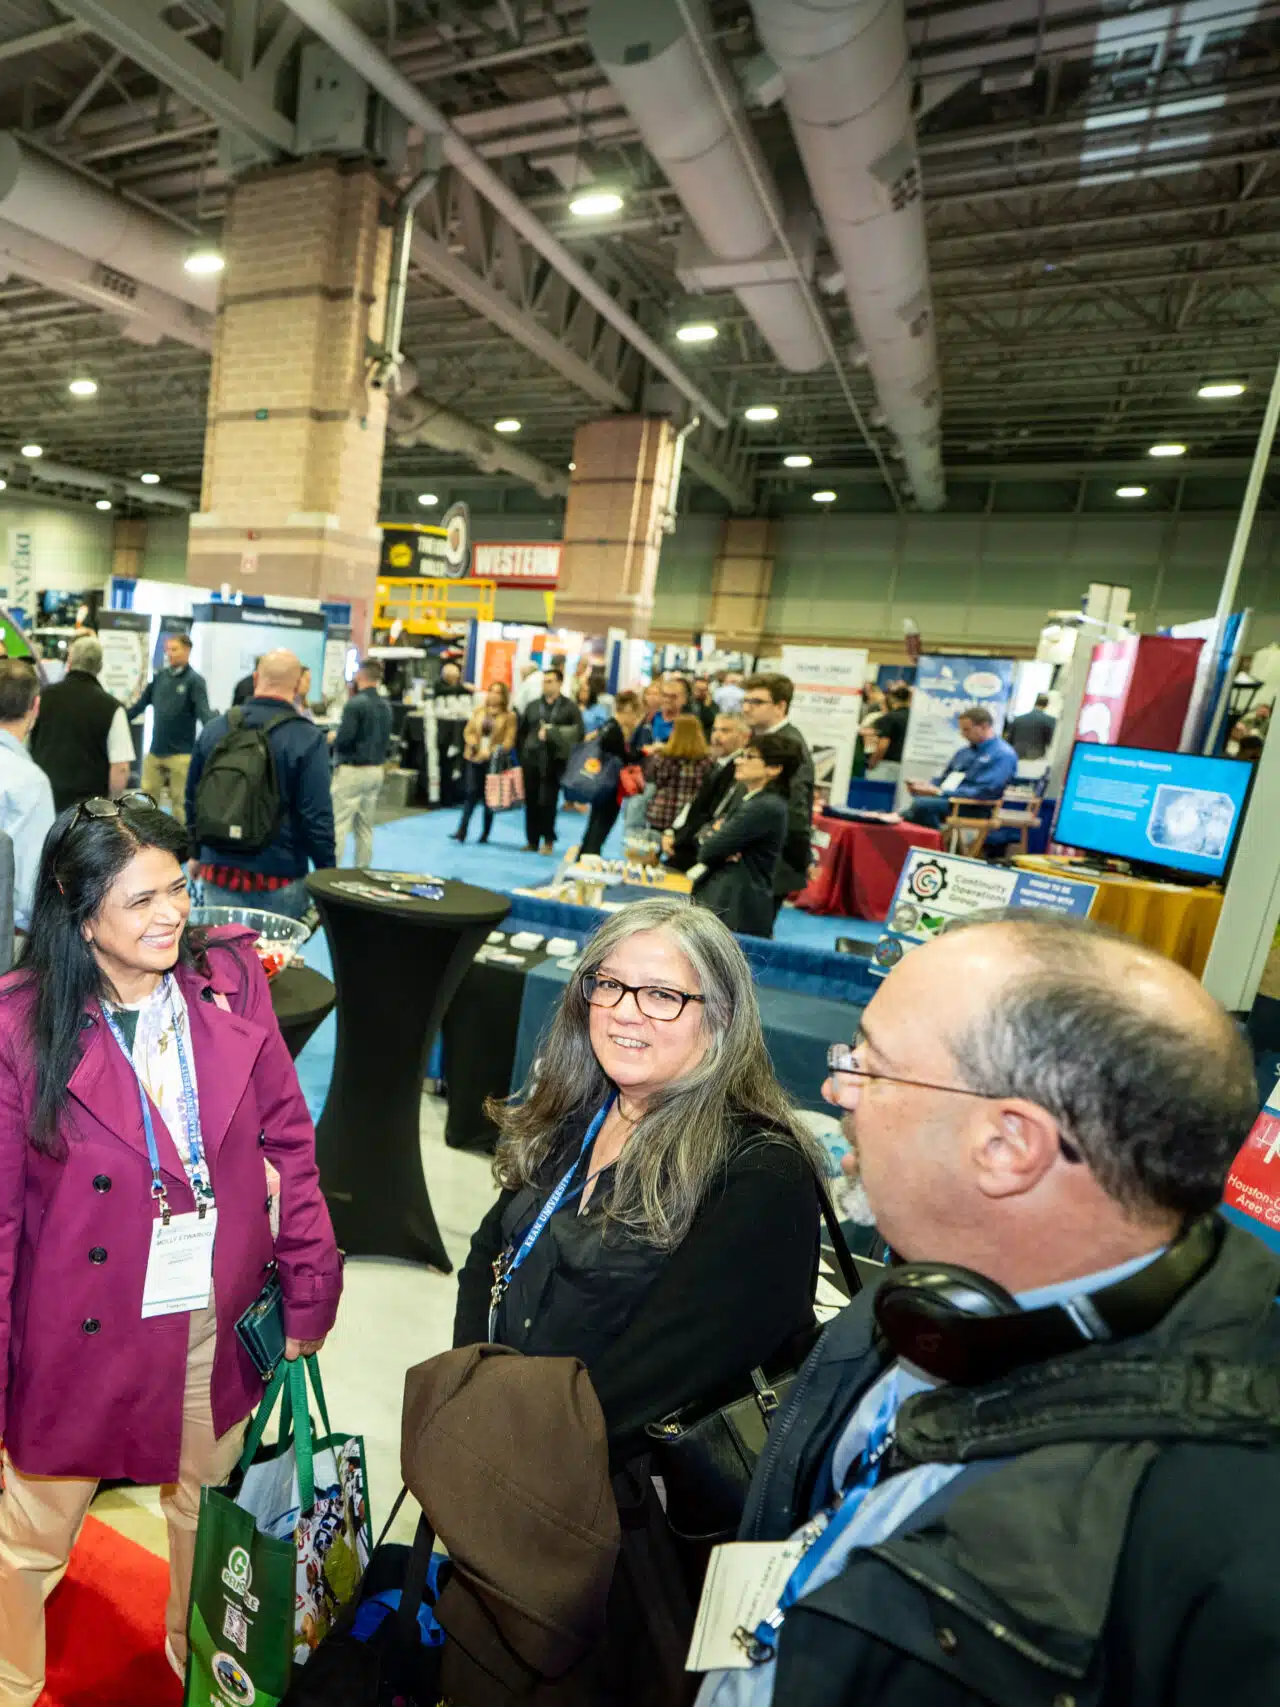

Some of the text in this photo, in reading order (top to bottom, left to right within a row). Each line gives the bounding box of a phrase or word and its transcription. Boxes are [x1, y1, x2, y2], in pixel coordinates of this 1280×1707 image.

[476, 546, 560, 576] WESTERN
[951, 884, 1006, 904] Operations
[954, 875, 1007, 893] Continuity
[948, 893, 979, 908] Group
[523, 1174, 573, 1248] KEAN UNIVERSITY
[1235, 1193, 1263, 1214] Area
